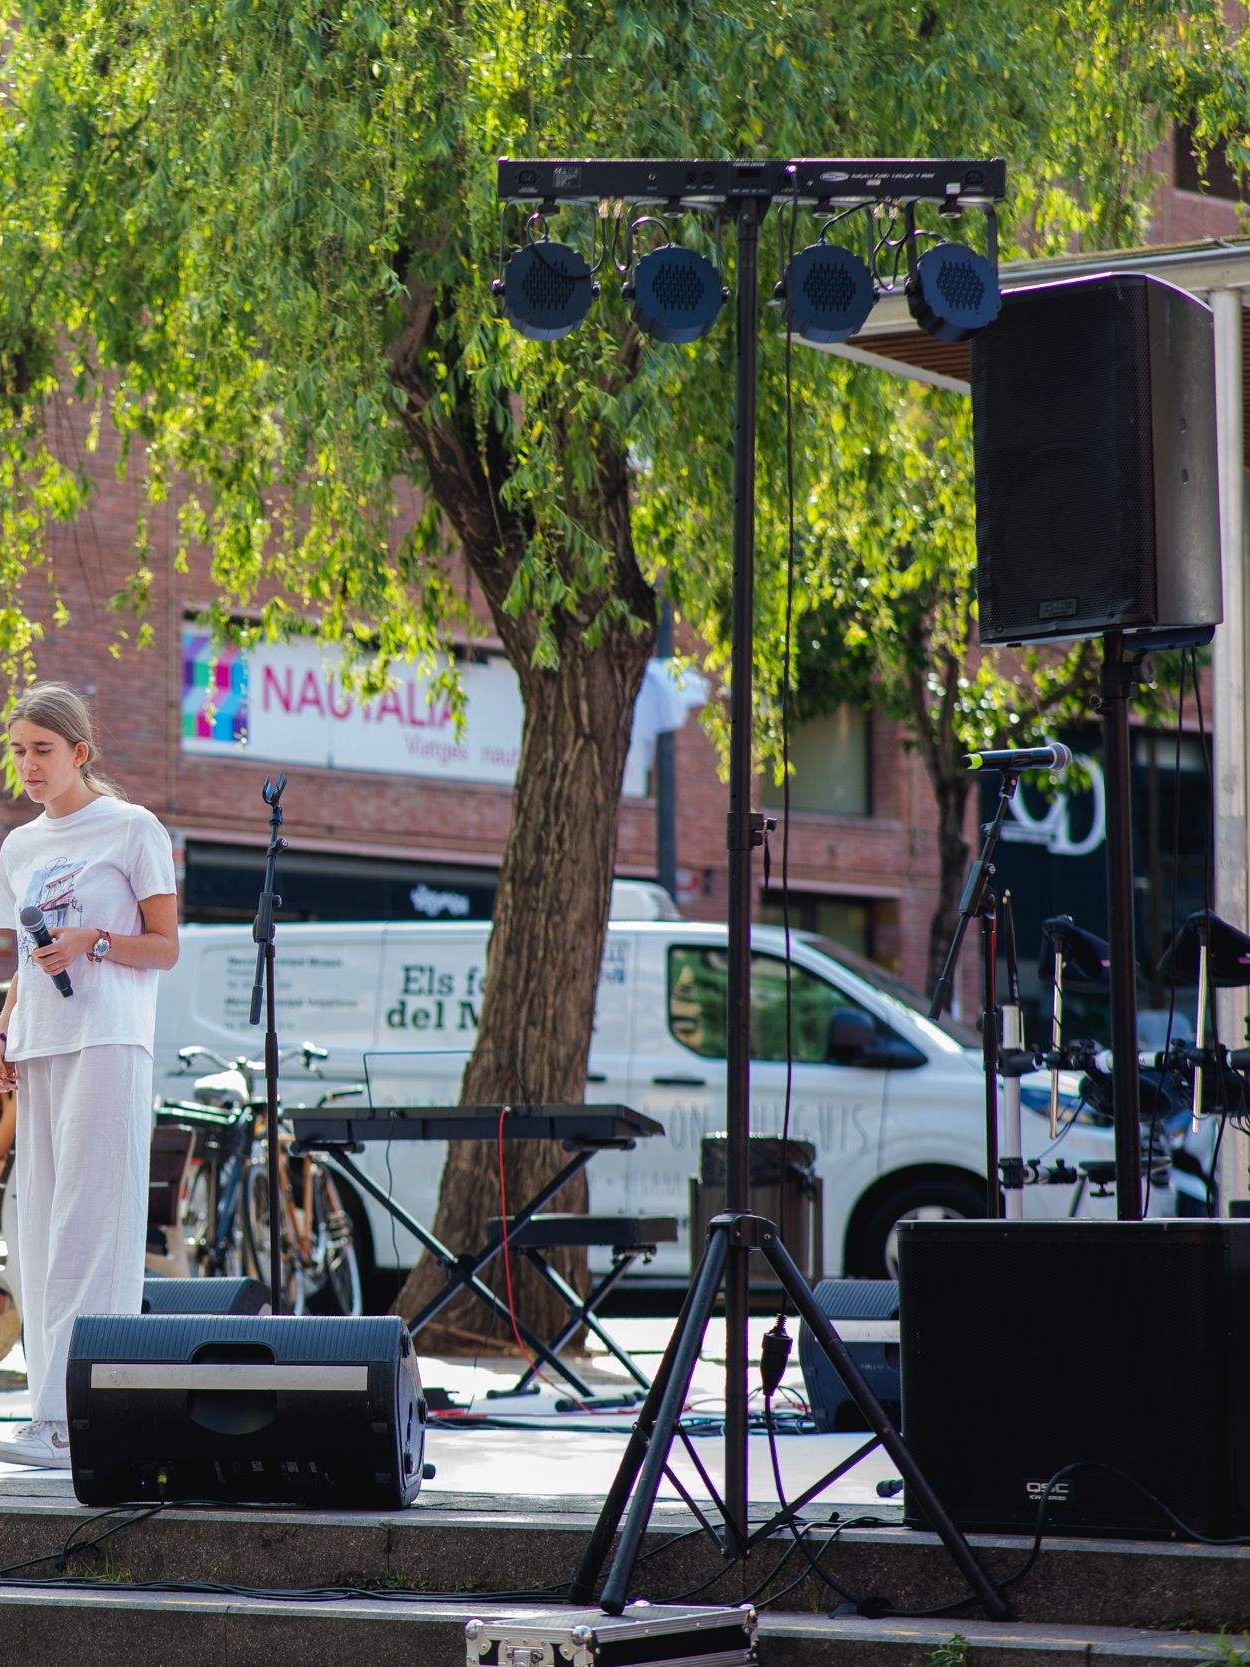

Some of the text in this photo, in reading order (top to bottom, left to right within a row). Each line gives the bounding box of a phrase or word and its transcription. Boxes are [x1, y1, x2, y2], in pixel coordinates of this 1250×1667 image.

[401, 964, 486, 996] Els f
[386, 999, 443, 1029] del
